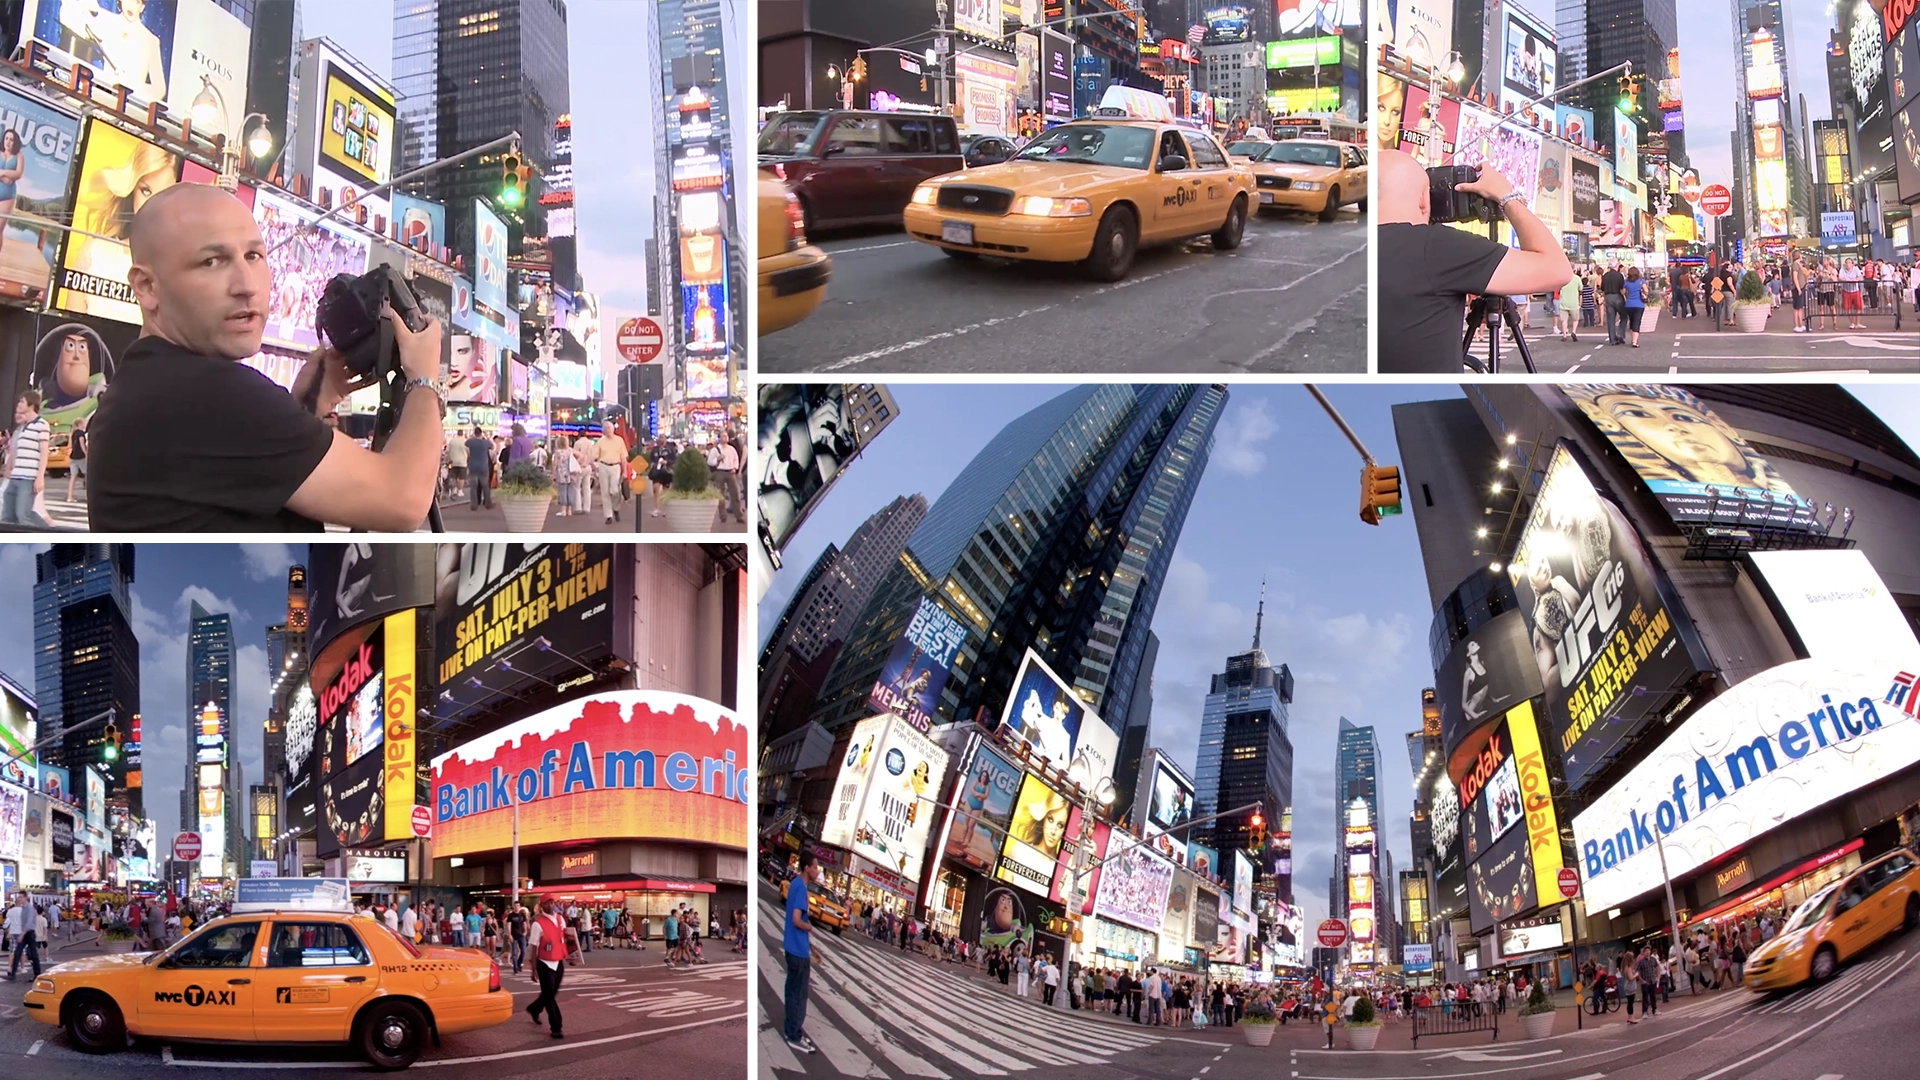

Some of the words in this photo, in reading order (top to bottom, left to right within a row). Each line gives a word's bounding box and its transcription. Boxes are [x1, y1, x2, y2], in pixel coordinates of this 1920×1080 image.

[1417, 10, 1442, 29] TOUS
[199, 51, 234, 82] TOUS
[0, 105, 73, 163] HUGE
[675, 176, 722, 190] TOSHIBA
[64, 271, 139, 304] FOREVER21.C
[625, 325, 639, 335] DO
[641, 325, 655, 335] NOT
[626, 346, 653, 355] ENTER
[439, 648, 464, 685] LIVE
[465, 636, 483, 668] ON
[485, 558, 610, 657] PAY-PER-VIEW
[455, 604, 489, 650] SAT.
[491, 569, 533, 626] JULY
[537, 558, 552, 594] 3
[922, 594, 967, 641] WINNER!
[1555, 560, 1623, 688] UFC
[1603, 561, 1625, 603] 116
[904, 628, 949, 670] MUSICAL
[908, 613, 957, 657] BEST
[320, 644, 373, 725] Kodak
[1561, 721, 1582, 753] LIVE
[1581, 704, 1596, 732] ON
[1592, 607, 1671, 715] PAY-PER-VIEW
[1567, 680, 1594, 721] SAT.
[1590, 641, 1619, 693] JULY
[1615, 629, 1630, 656] 3
[387, 673, 412, 783] Kodak
[973, 756, 1017, 794] HUGE
[1089, 746, 1108, 766] TOUS
[1459, 735, 1505, 810] Kodak
[437, 765, 512, 823] Bank
[517, 748, 561, 803] of
[1518, 749, 1554, 852] Kodak
[1582, 808, 1654, 879] Bank
[1655, 773, 1689, 835] of
[1693, 693, 1883, 813] America
[346, 849, 406, 858] MARQUIS
[562, 853, 595, 870] Marriott
[1001, 857, 1050, 886] FOREVER21.COM
[1717, 860, 1747, 888] Marriott
[1501, 915, 1562, 930] MARQUIS
[381, 964, 408, 974] 9H12
[155, 991, 182, 1003] NYC
[185, 985, 236, 1006] TAXI
